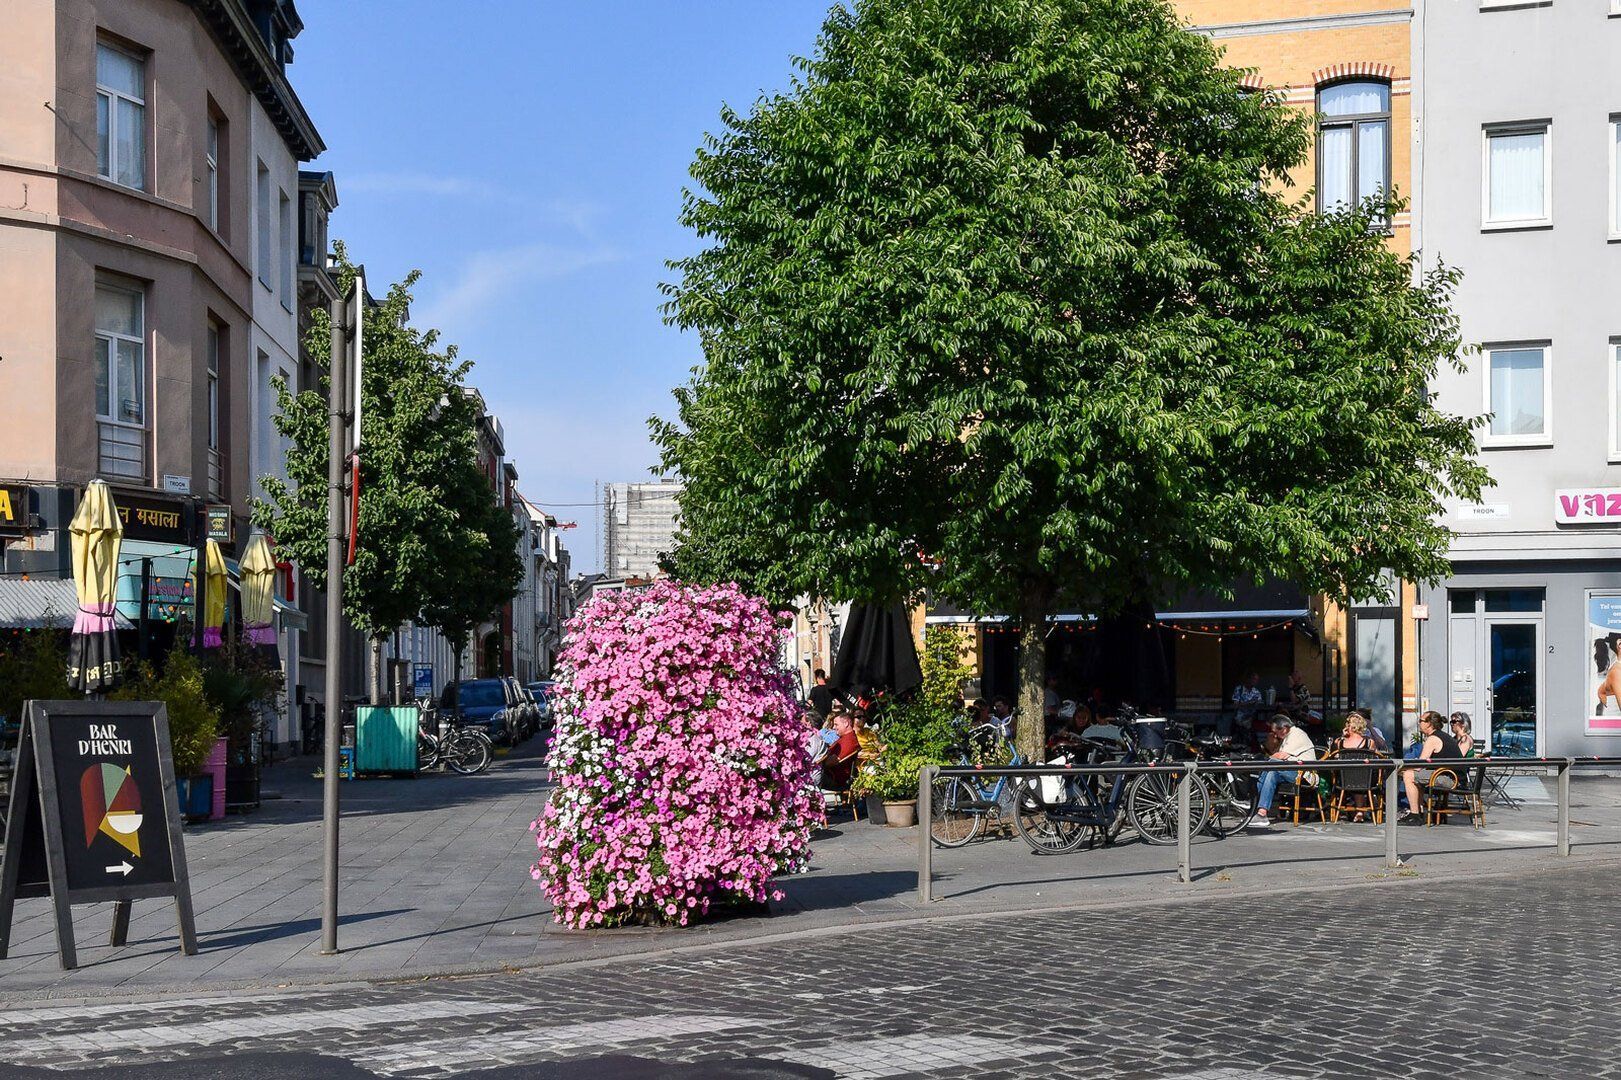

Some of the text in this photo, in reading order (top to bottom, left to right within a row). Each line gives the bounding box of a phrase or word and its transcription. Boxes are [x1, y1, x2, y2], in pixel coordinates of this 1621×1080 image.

[1548, 645, 1554, 653] 2
[415, 670, 424, 681] P
[89, 724, 118, 740] BAR
